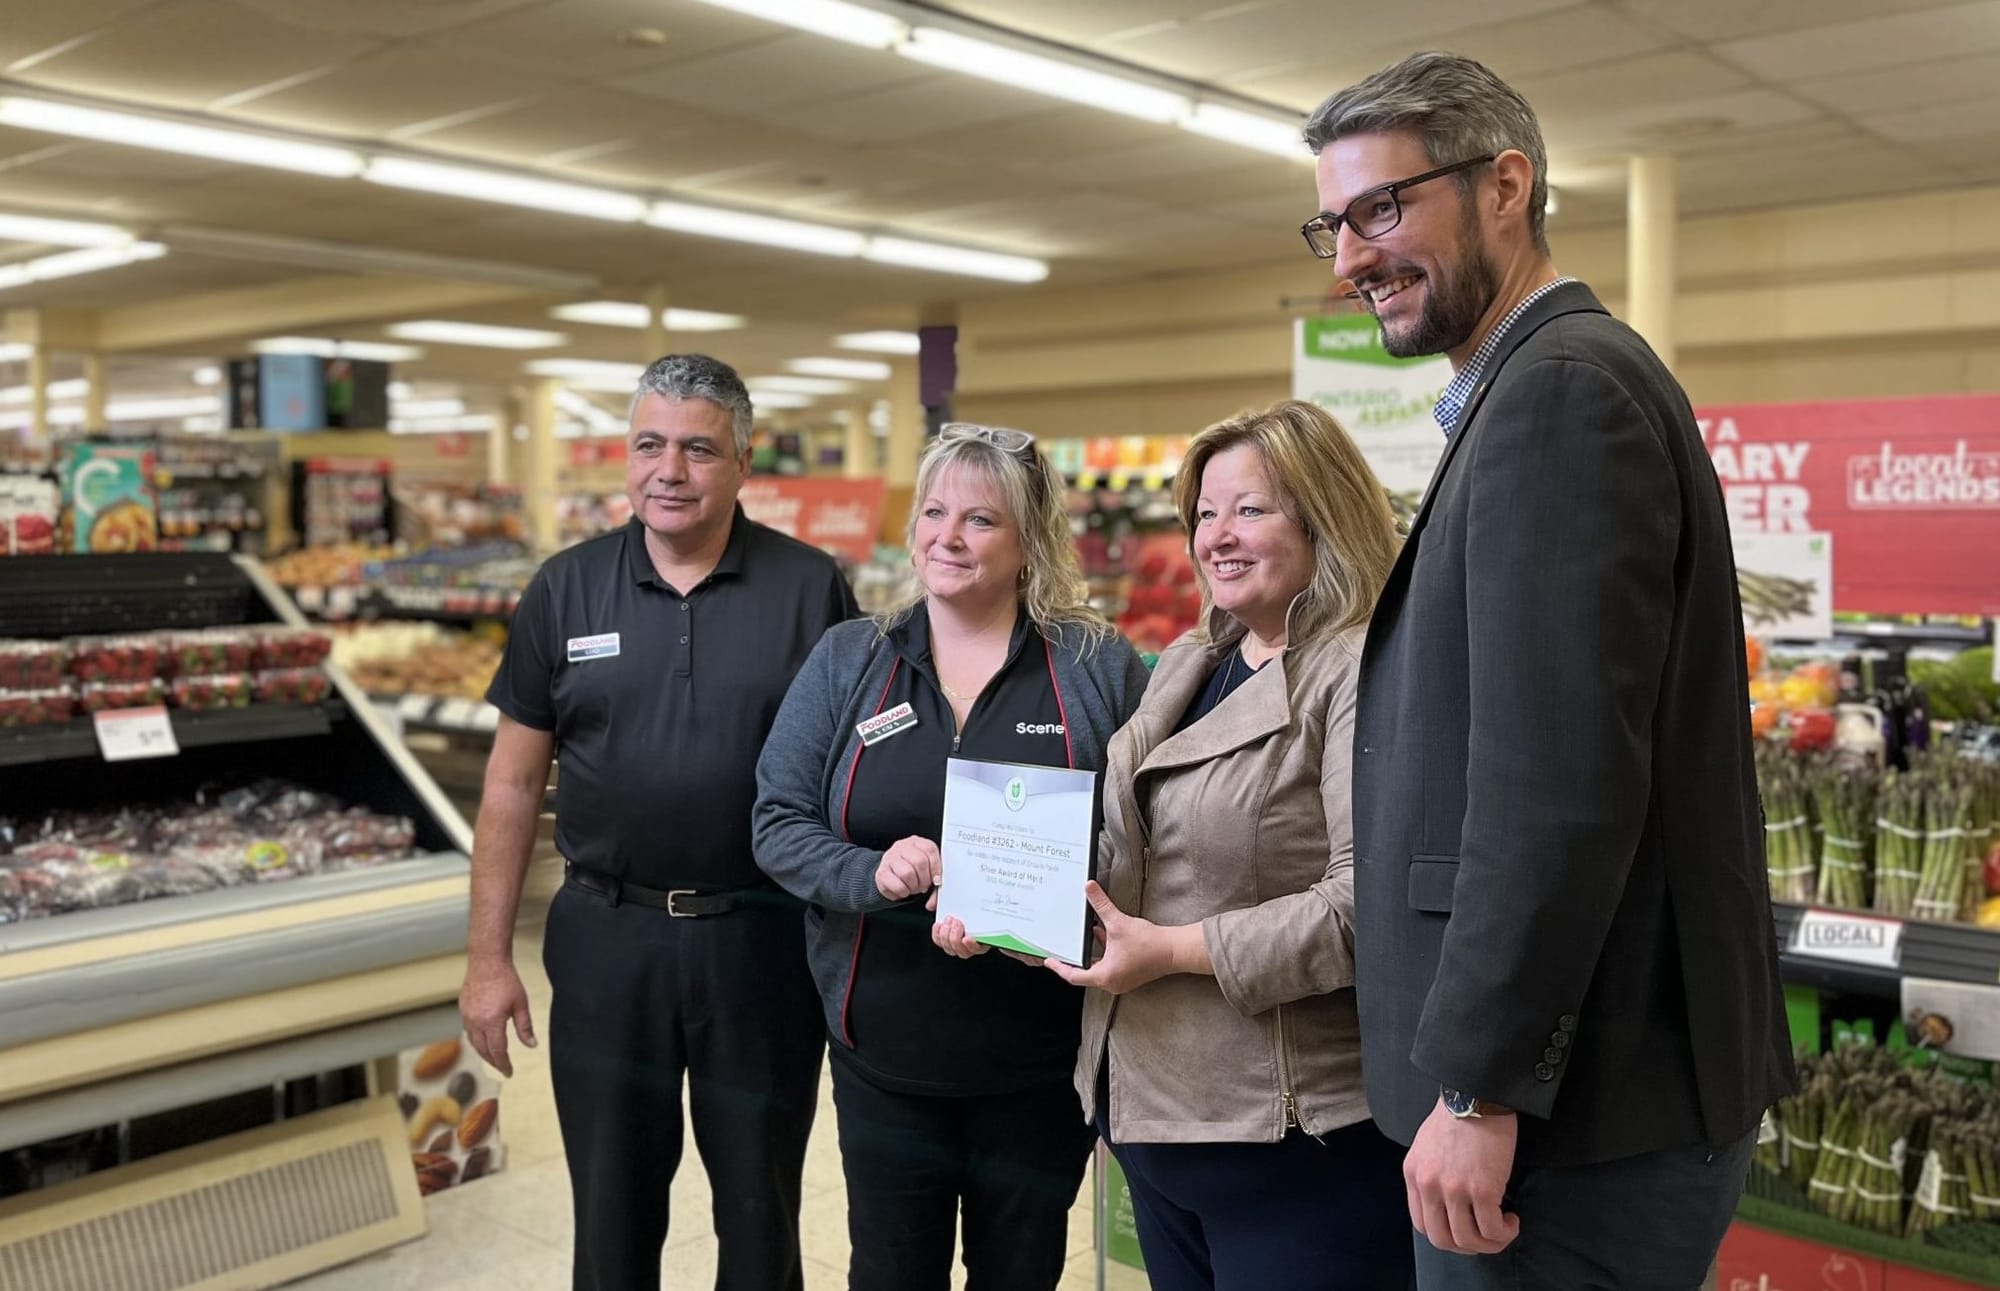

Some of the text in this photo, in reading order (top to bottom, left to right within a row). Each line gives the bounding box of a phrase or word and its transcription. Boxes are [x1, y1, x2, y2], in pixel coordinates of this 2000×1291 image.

[1716, 417, 1739, 442] A
[1015, 721, 1065, 735] Scene
[958, 830, 990, 844] Foodland
[1046, 845, 1071, 859] Forest
[1813, 925, 1873, 942] LOCAL
